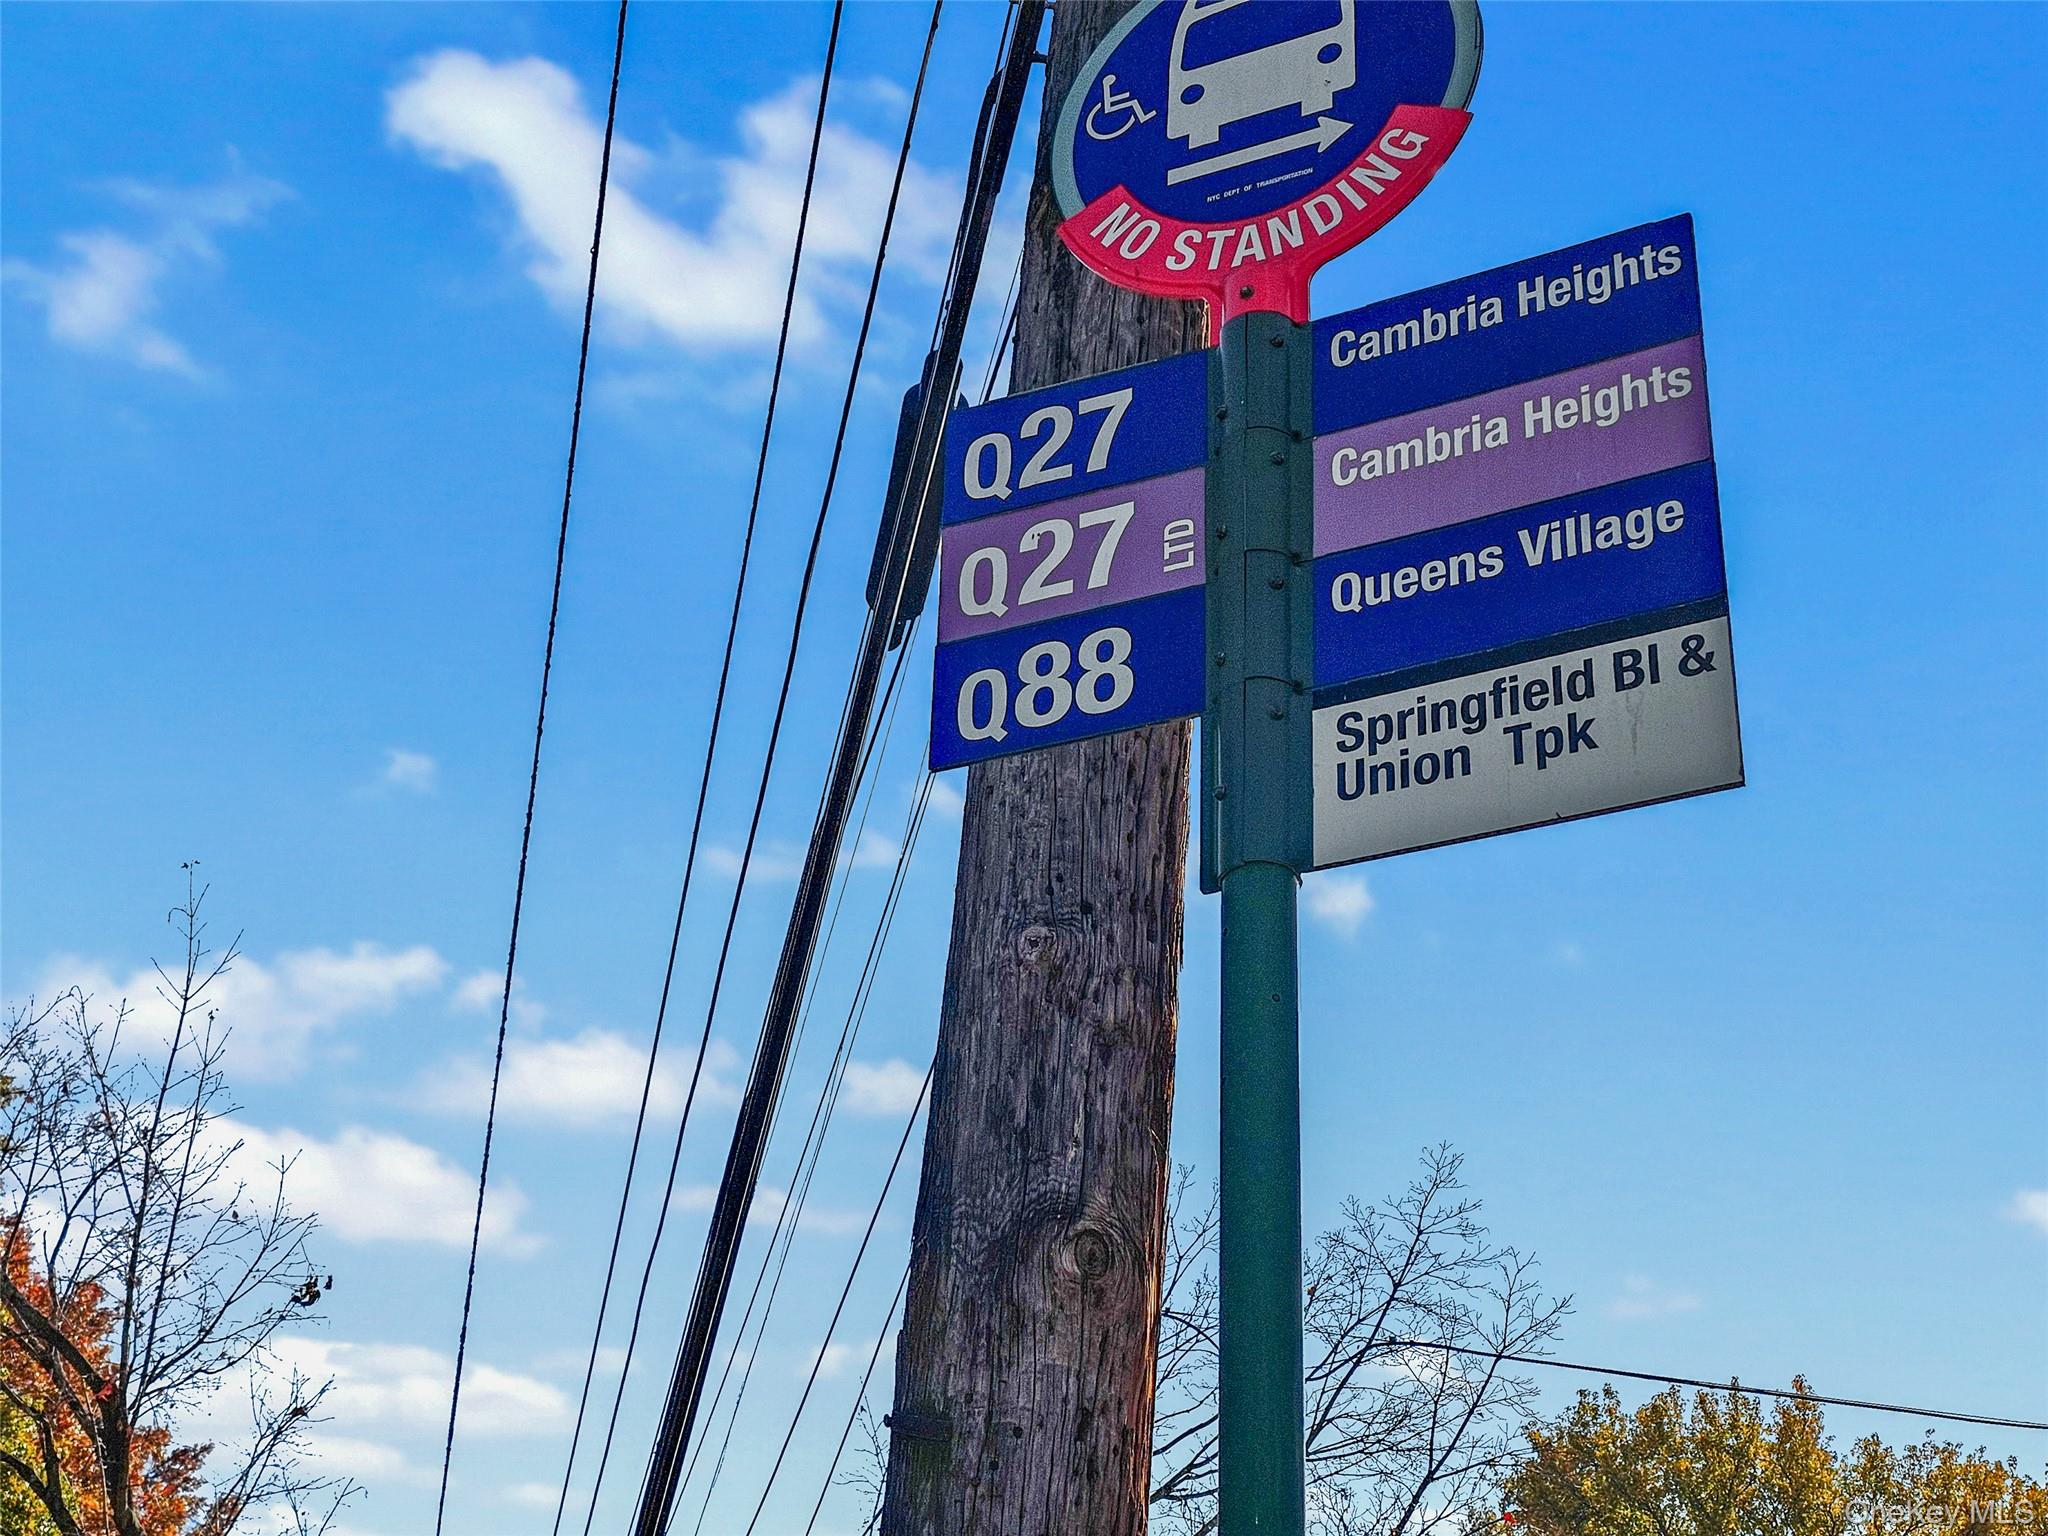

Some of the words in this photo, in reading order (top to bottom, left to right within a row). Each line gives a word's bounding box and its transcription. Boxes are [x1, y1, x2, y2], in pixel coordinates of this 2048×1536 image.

[1090, 201, 1162, 261] NO
[1165, 128, 1430, 271] STANDING
[1223, 188, 1240, 198] DEPT
[1243, 184, 1253, 192] OF
[1330, 294, 1503, 368] Cambria
[1517, 244, 1683, 317] Heights
[963, 387, 1134, 501] Q27
[1330, 414, 1508, 487] Cambria
[1523, 366, 1693, 439] Heights
[959, 501, 1135, 618] Q27
[1163, 518, 1195, 573] LTD
[1330, 544, 1504, 614] Queens
[1518, 499, 1685, 567] Village
[957, 626, 1135, 742] Q88
[1336, 658, 1595, 756] Springfield
[1613, 643, 1661, 693] Bl
[1678, 634, 1717, 678] &
[1336, 743, 1471, 801] Union
[1503, 712, 1599, 771] Tpk
